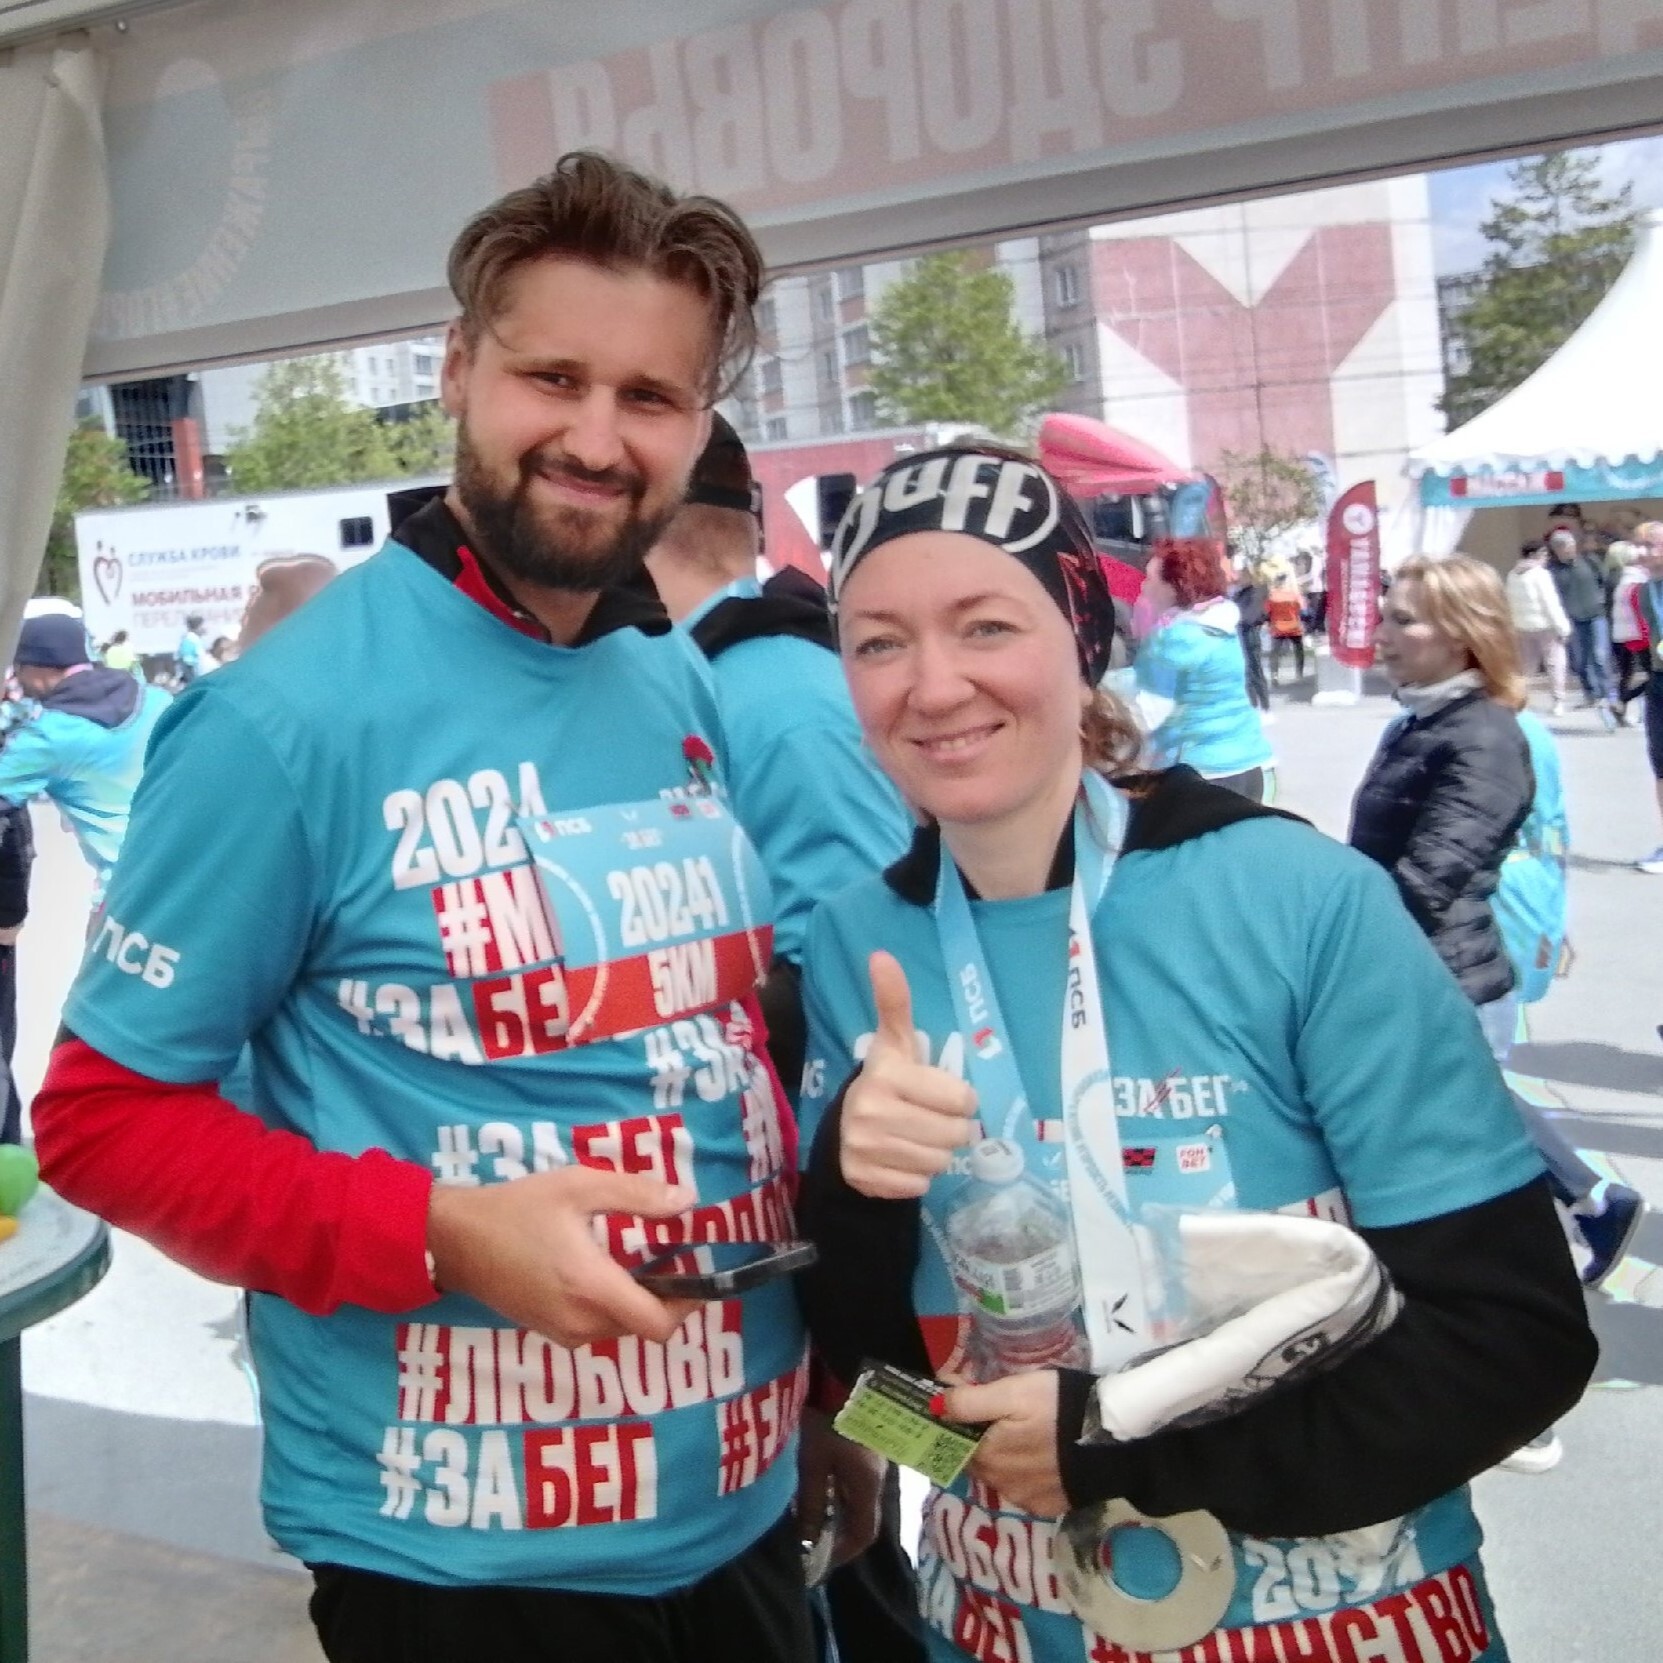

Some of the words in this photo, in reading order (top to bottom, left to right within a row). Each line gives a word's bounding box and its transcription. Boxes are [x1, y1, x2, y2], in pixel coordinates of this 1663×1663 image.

[128, 549, 186, 567] СЛУЖБА
[190, 545, 240, 560] КРОВИ
[131, 586, 243, 607] МОБИЛЬНАЯ
[606, 855, 728, 949] 20241
[91, 914, 181, 989] ПСБ
[647, 938, 718, 1019] 5КМ
[337, 964, 567, 1066] #ЗАБЕ
[959, 962, 989, 1025] ПСБ
[1069, 966, 1087, 1030] ПСБ
[397, 1300, 745, 1426] #ЛЮБОВЬ
[375, 1423, 658, 1531] #ЗАБЕГ
